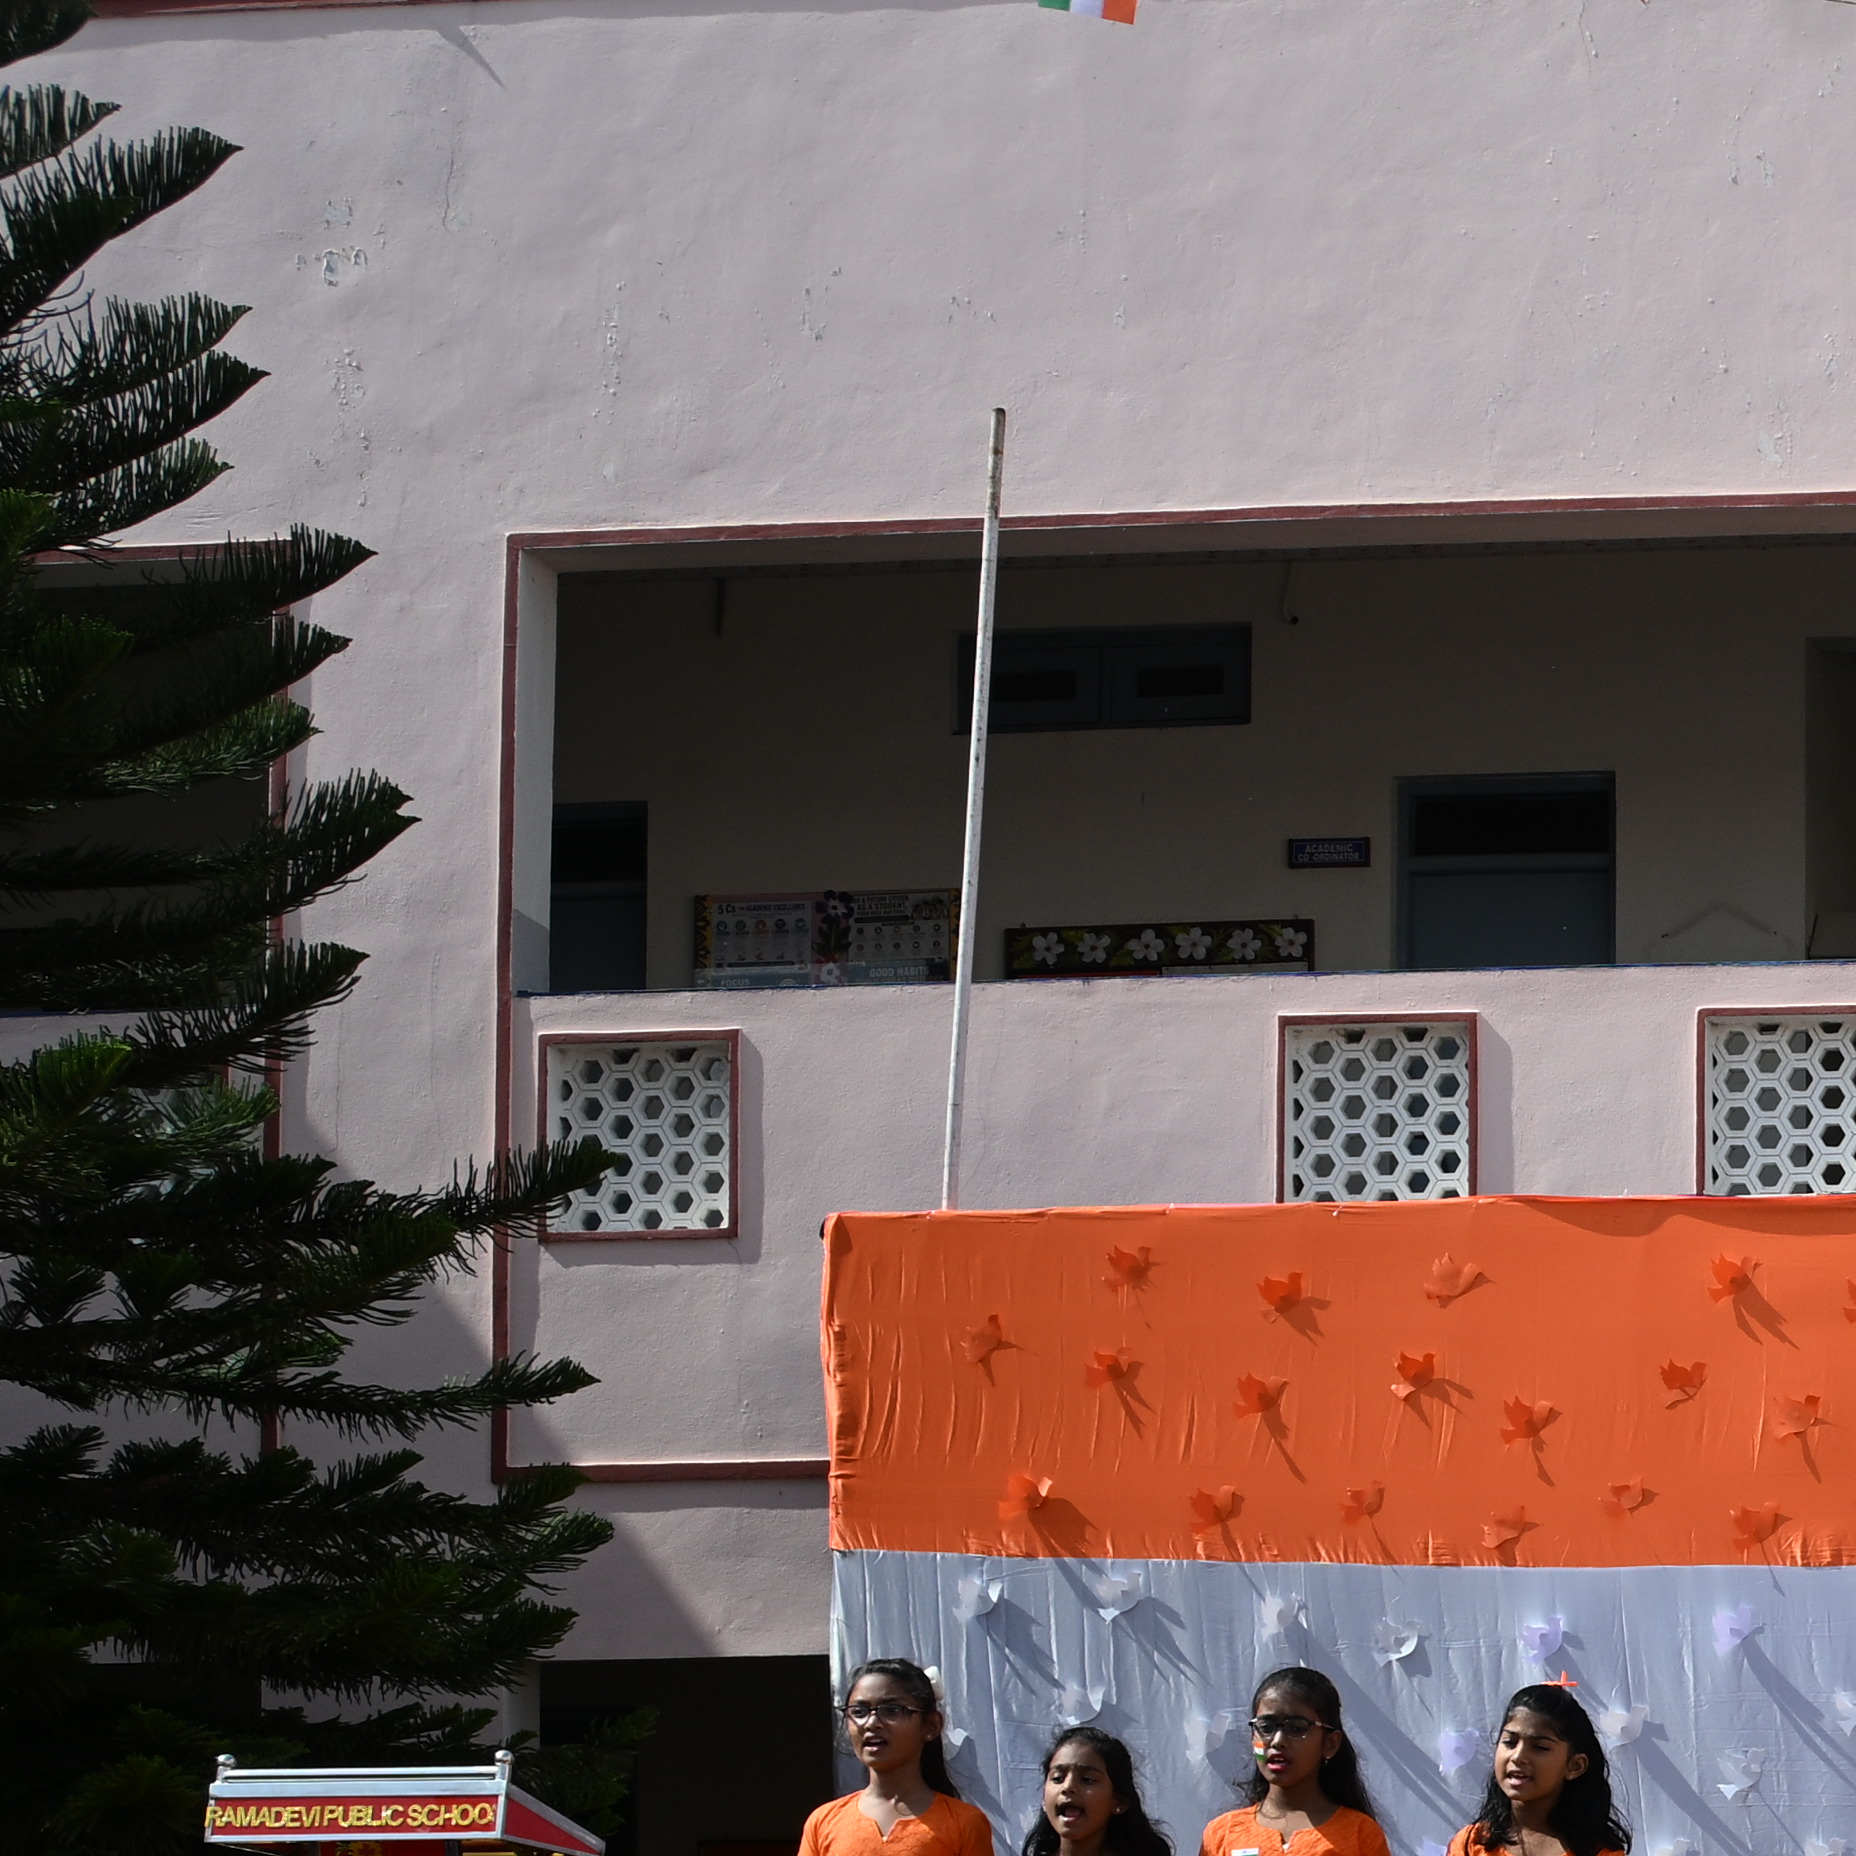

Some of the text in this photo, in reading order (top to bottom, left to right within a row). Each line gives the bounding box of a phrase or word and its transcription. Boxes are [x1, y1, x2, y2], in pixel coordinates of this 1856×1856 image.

[1305, 843, 1353, 852] ACADEMIC
[869, 968, 895, 978] GOOD
[720, 978, 750, 987] FOCUS
[204, 1805, 320, 1829] RAMADEVI
[323, 1804, 404, 1827] PUBLIC
